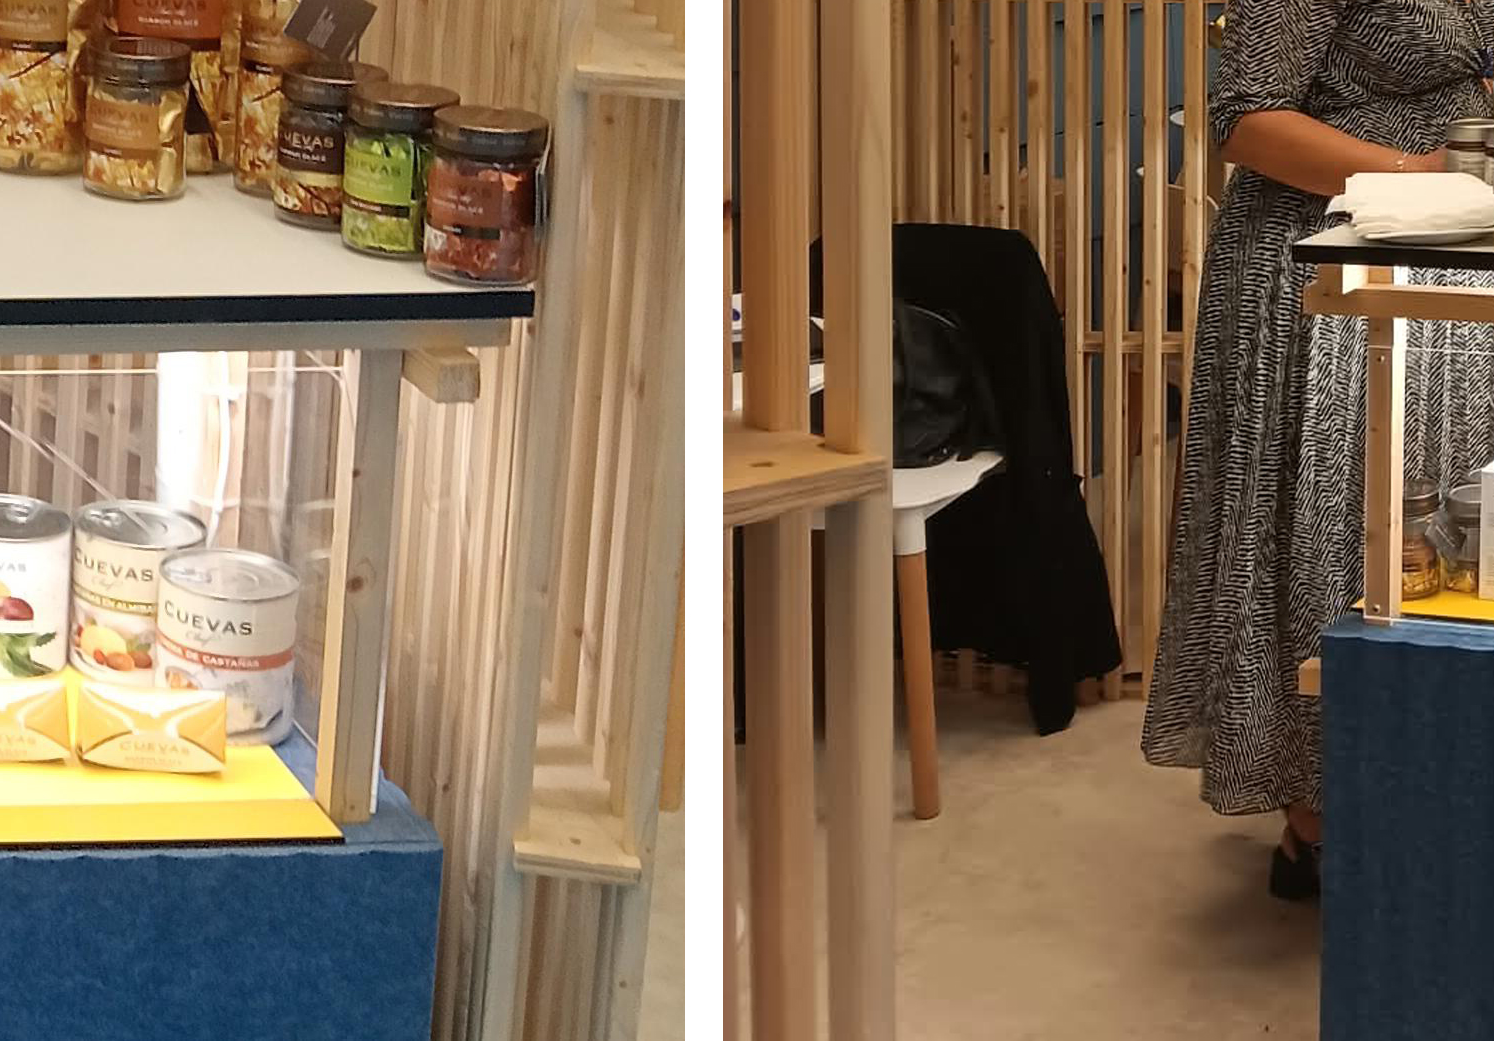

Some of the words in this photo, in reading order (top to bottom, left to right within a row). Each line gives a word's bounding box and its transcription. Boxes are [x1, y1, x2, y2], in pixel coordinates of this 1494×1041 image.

[281, 130, 334, 149] UEVAS
[74, 547, 154, 582] CUEVAS
[164, 599, 253, 636] CUEVAS
